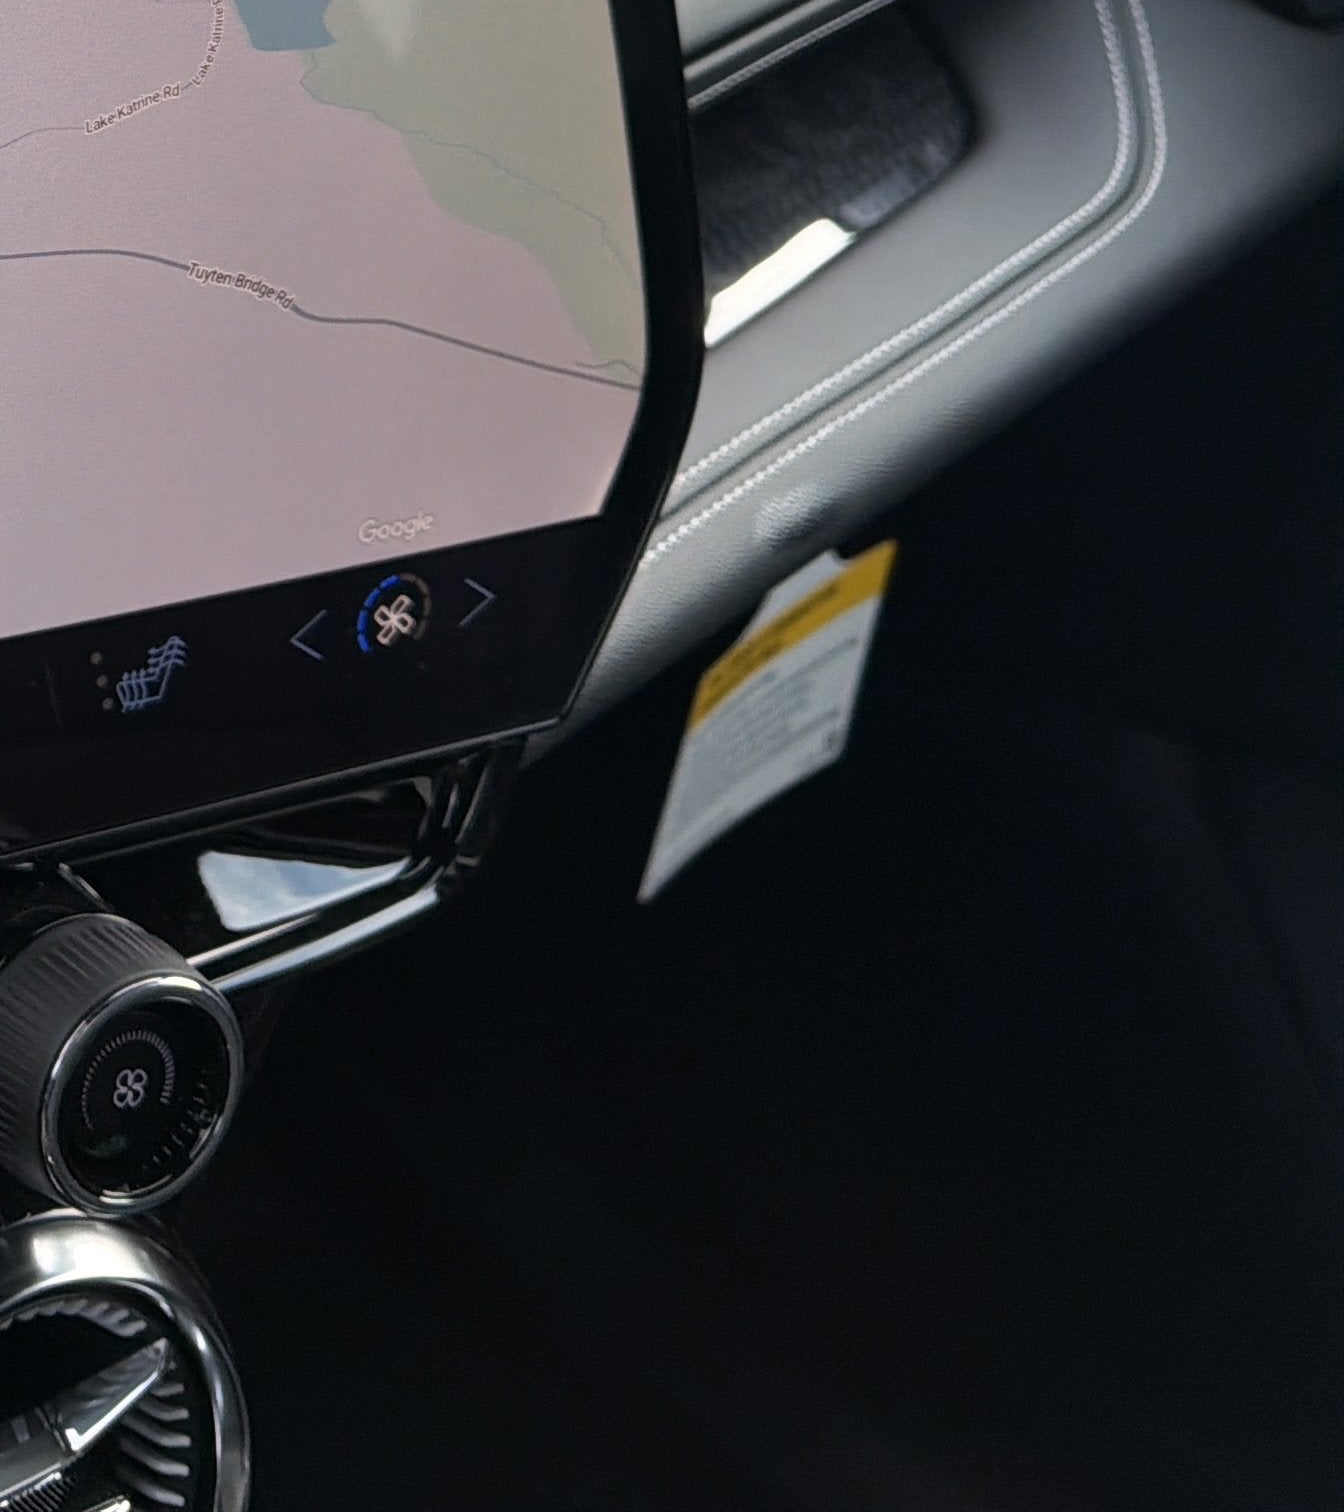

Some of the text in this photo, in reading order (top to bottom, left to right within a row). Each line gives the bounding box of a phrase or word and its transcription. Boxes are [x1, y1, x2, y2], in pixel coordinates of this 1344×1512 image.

[192, 55, 213, 85] Lake
[85, 84, 180, 134] Lake Katrine Rd
[188, 262, 293, 309] Tuyten Bridge Rd
[358, 510, 433, 542] Google
